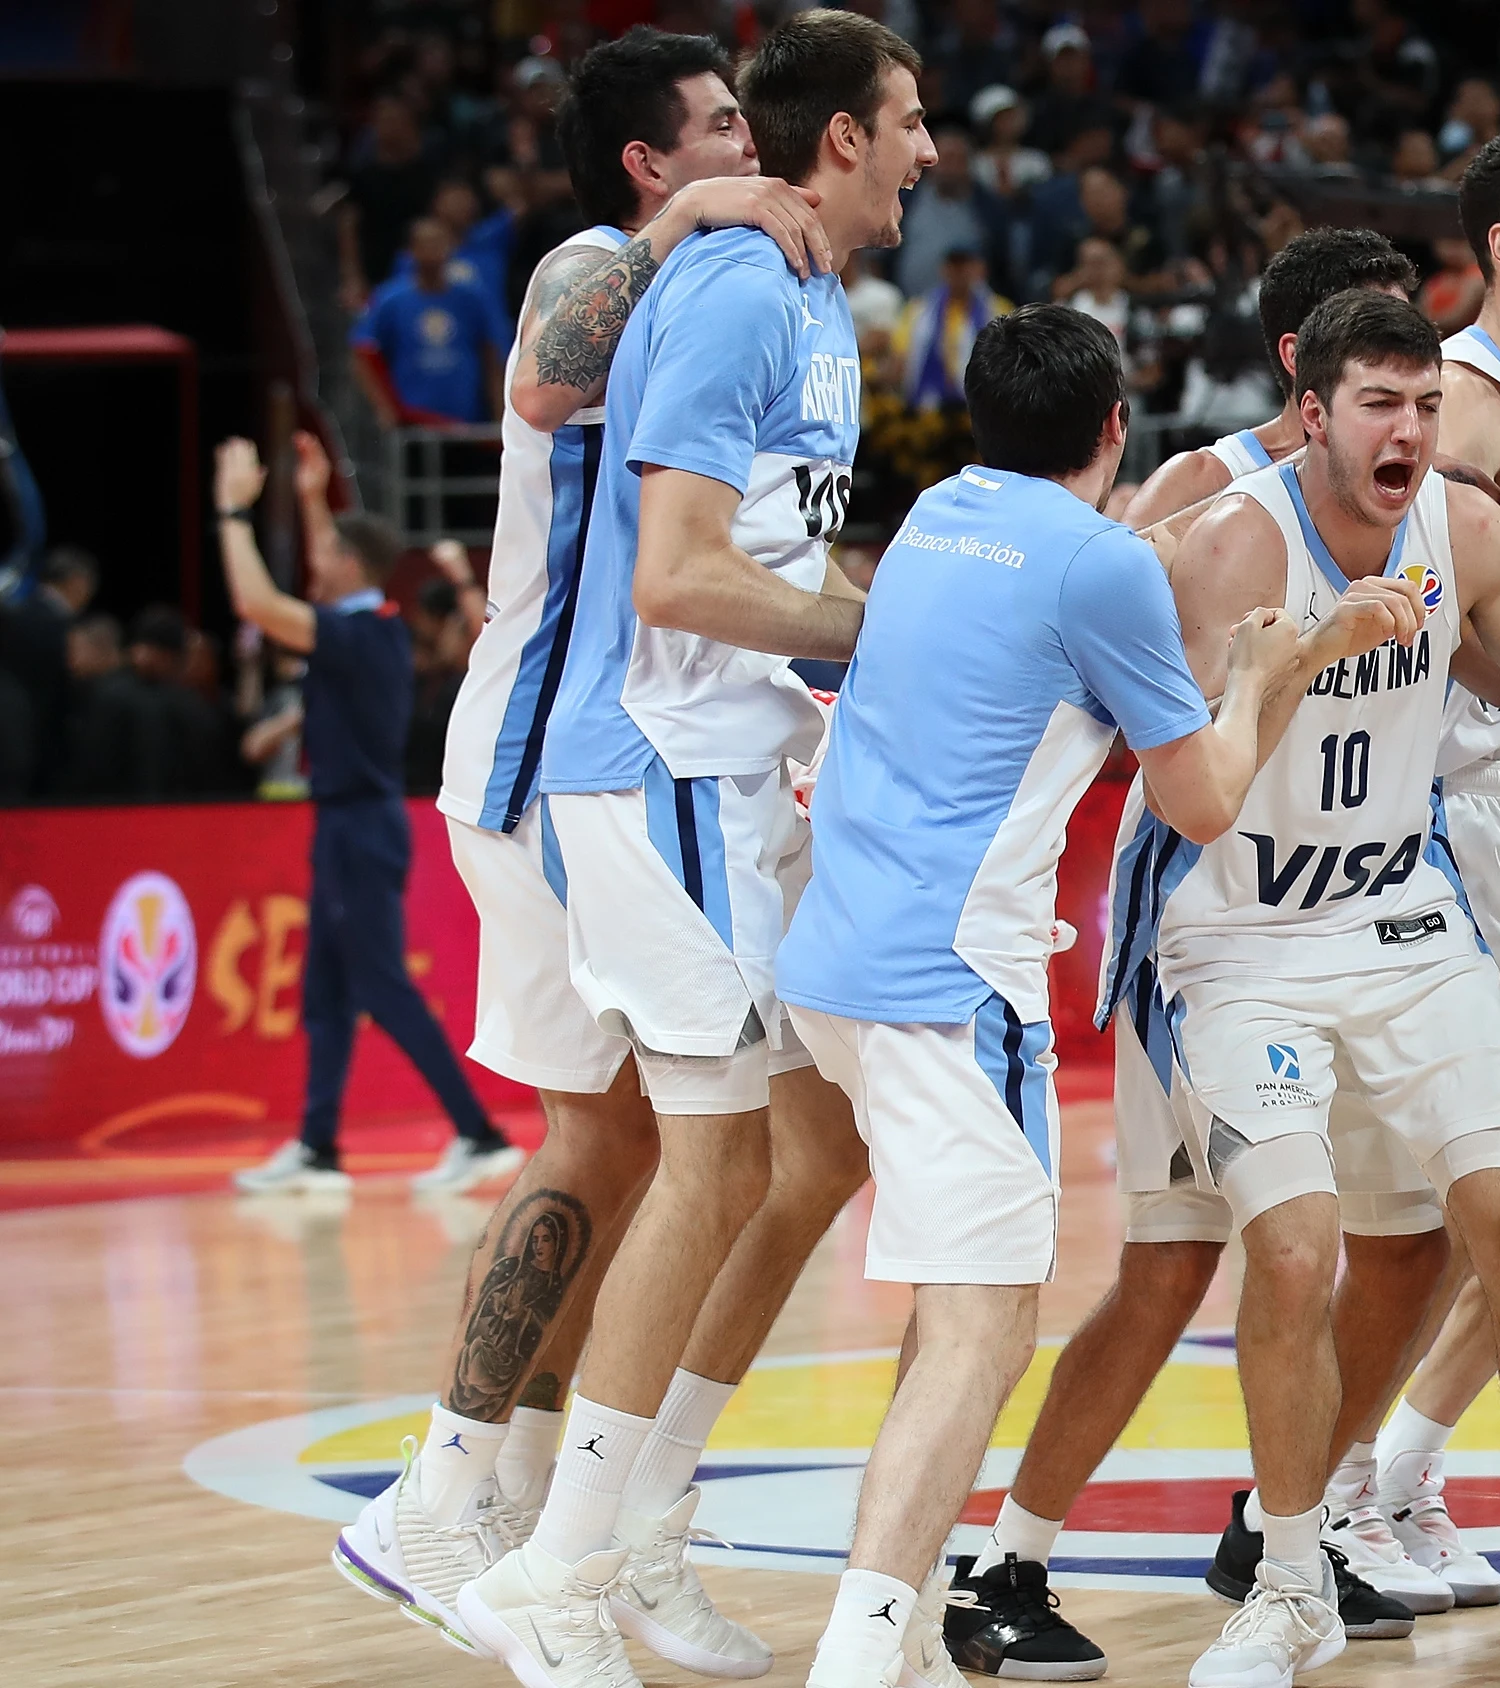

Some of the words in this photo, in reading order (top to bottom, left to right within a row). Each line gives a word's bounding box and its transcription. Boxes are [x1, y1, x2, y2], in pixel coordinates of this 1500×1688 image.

[900, 525, 952, 552] Banco
[950, 536, 1026, 568] Nación
[1320, 730, 1371, 811] 10
[1237, 832, 1422, 910] VISA
[1255, 1082, 1277, 1092] PAN
